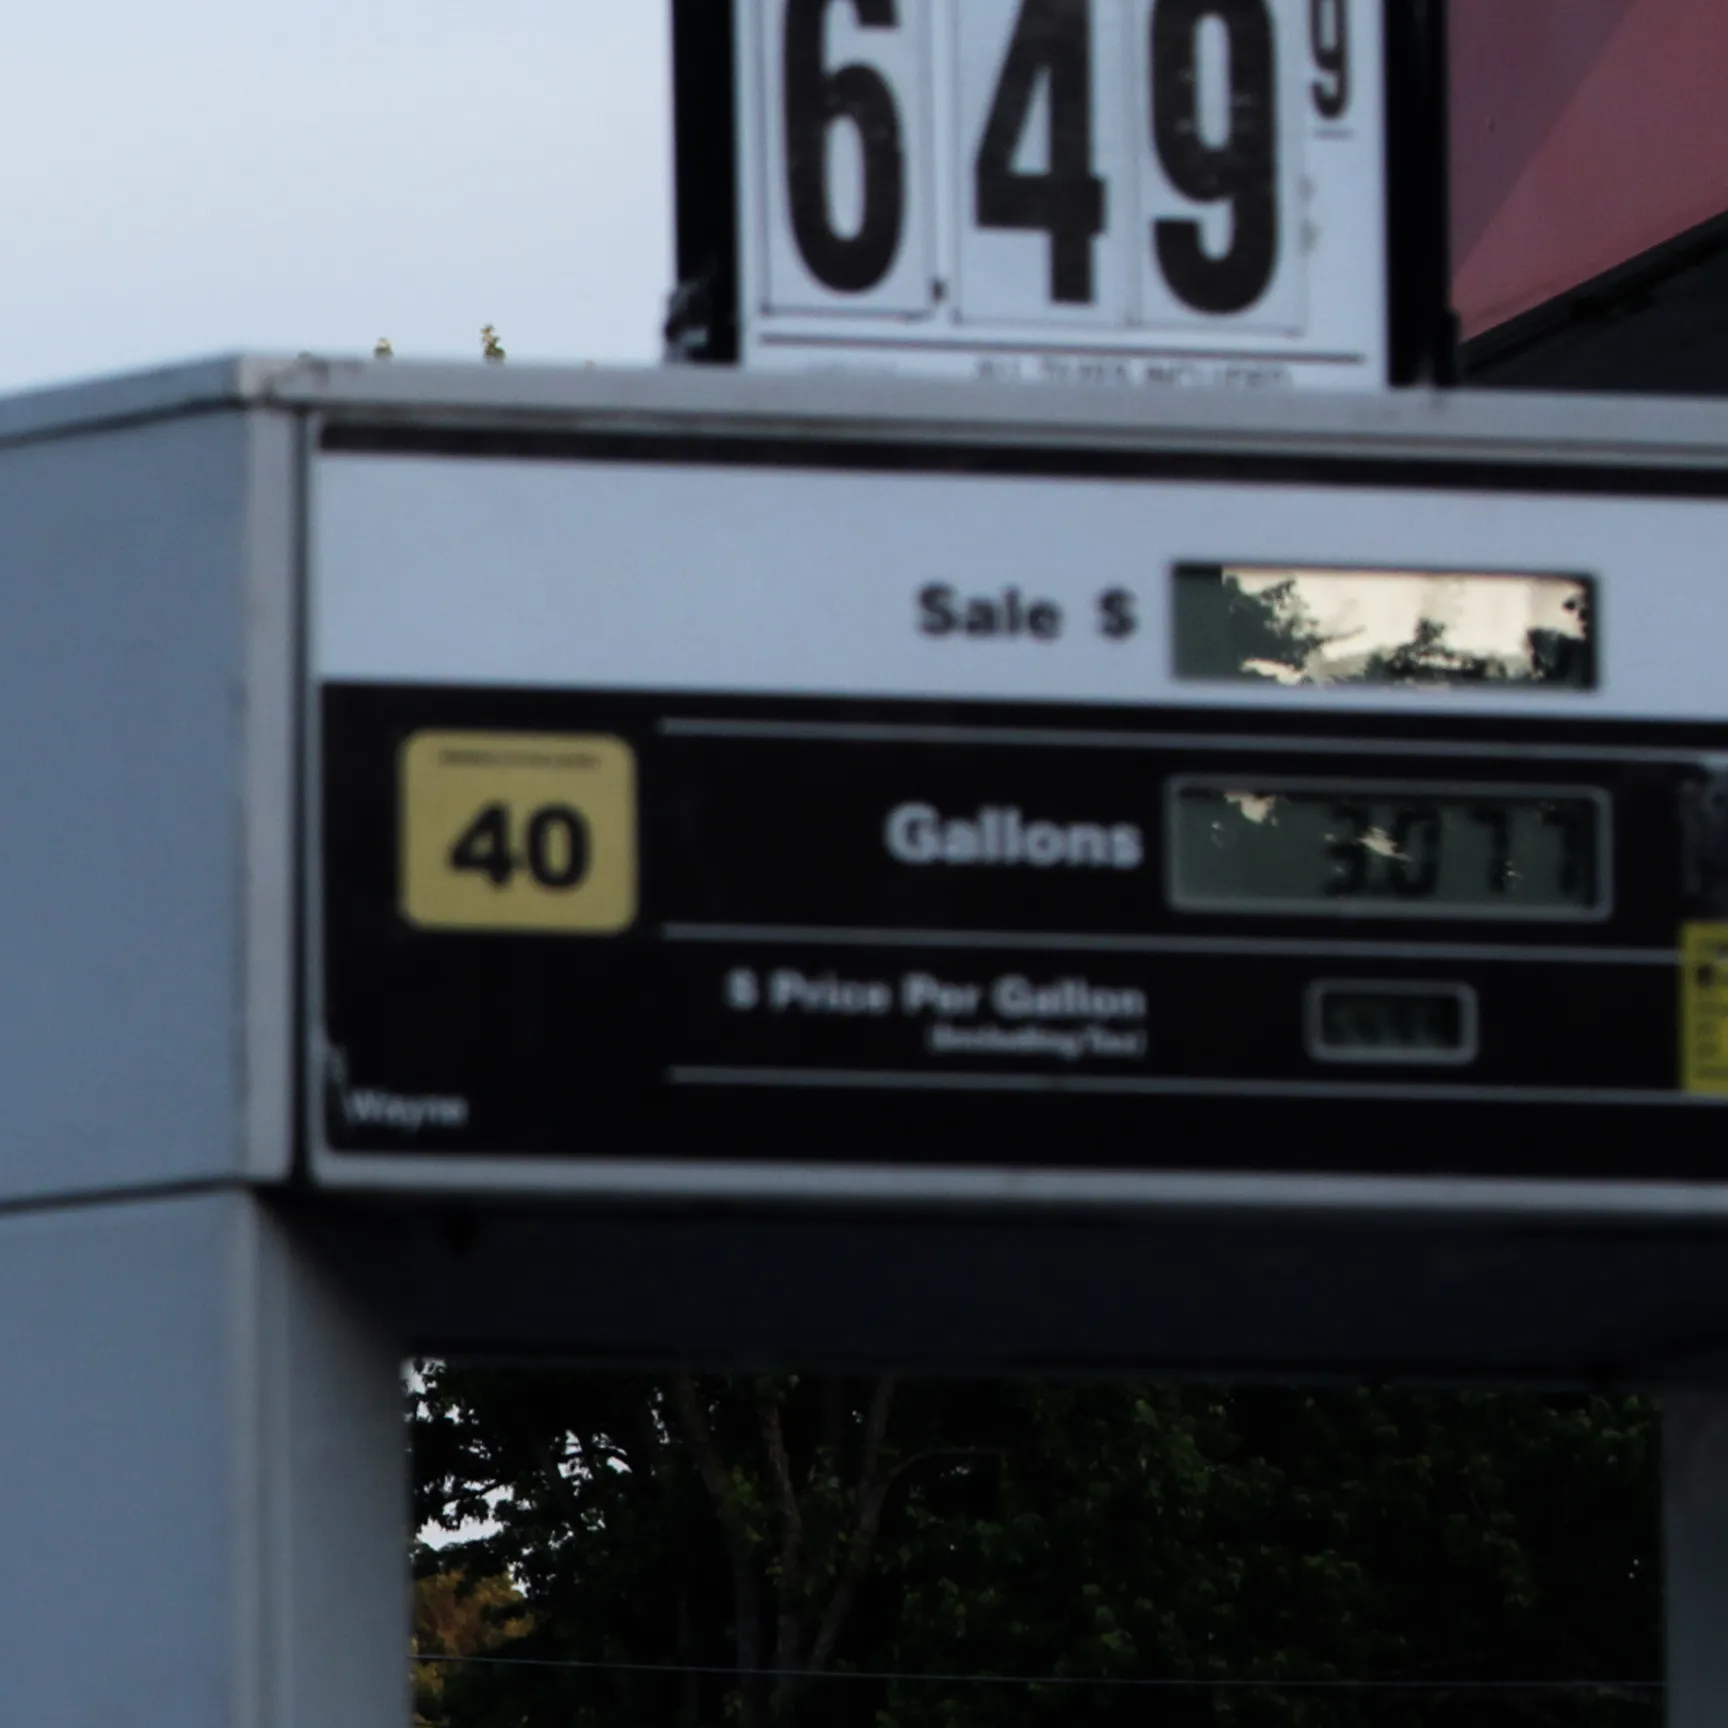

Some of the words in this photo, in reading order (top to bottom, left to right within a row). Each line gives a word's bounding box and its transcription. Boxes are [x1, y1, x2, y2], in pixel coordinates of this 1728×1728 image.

[917, 584, 1061, 641] Sale
[449, 801, 591, 893] 40
[888, 802, 1143, 870] Gallons
[766, 969, 894, 1015] Price
[900, 973, 982, 1016] Per
[989, 974, 1150, 1019] Gallon
[345, 1088, 470, 1134] Wayne
